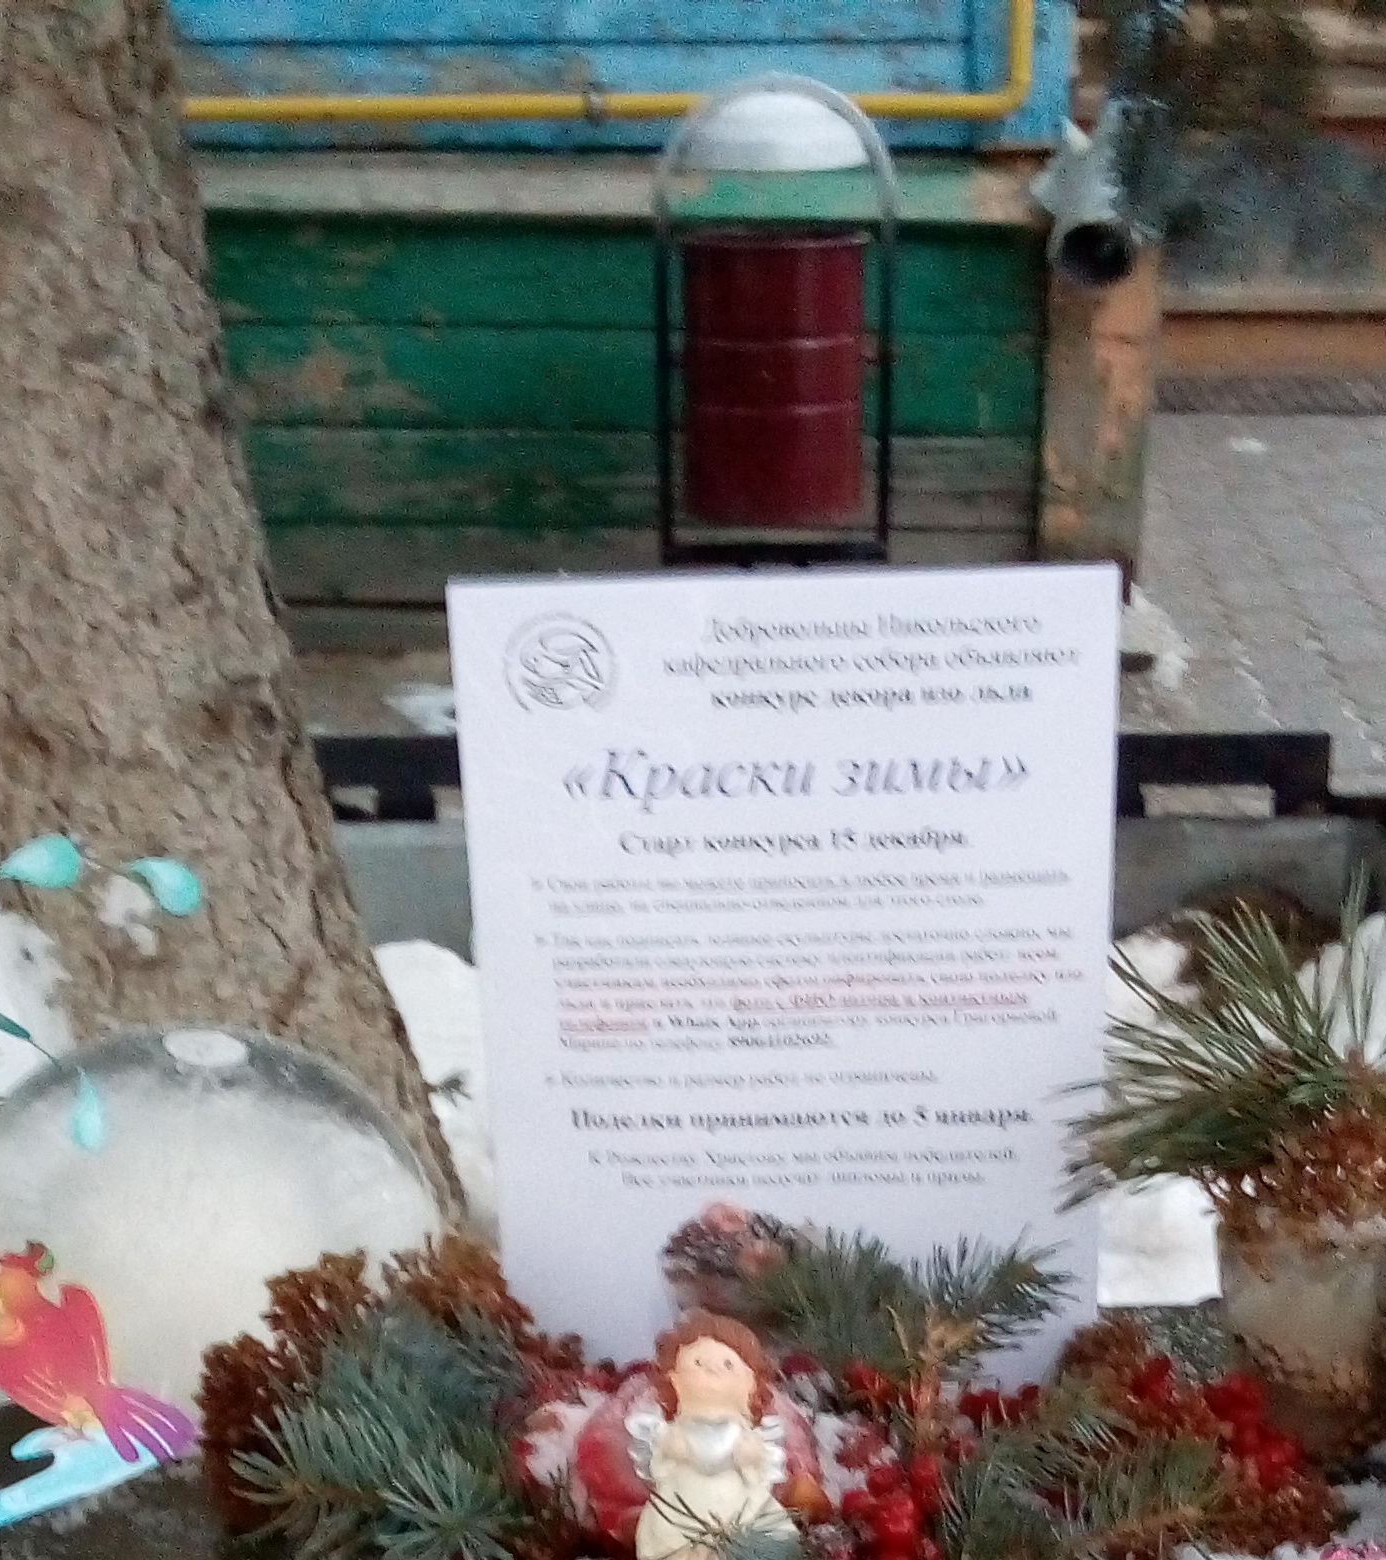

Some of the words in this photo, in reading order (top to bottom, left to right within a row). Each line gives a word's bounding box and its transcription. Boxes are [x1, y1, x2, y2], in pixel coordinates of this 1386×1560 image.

[709, 687, 818, 713] конкурс
[560, 748, 816, 815] «Краски
[833, 753, 1031, 799] зимы»
[617, 830, 694, 859] Старт
[703, 831, 821, 858] конкурса
